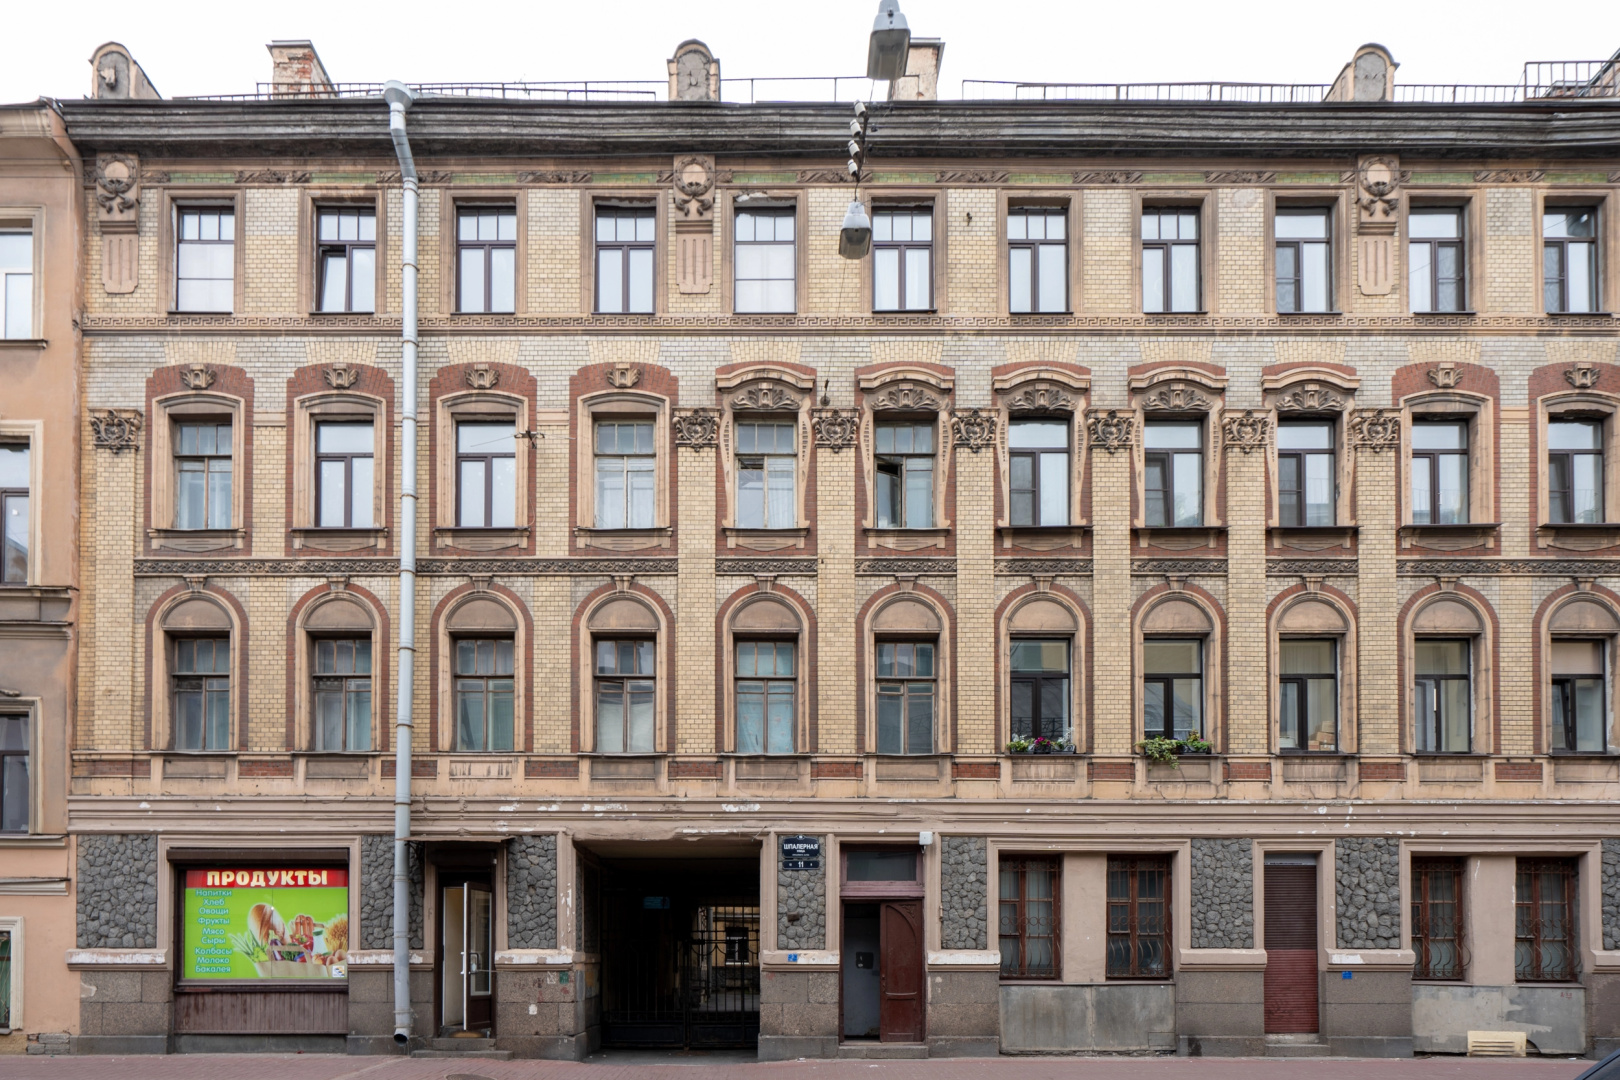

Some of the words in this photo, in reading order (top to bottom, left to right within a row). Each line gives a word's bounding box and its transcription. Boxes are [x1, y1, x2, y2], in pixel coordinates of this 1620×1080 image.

[207, 870, 328, 887] ПРОДУКТЫ
[195, 889, 232, 897] Напитки
[203, 898, 225, 906] Хлеб
[199, 907, 229, 915] Овощи
[197, 917, 230, 925] Фрукты
[201, 936, 226, 945] Сыры
[195, 947, 232, 955] Колбасы
[195, 965, 231, 973] Бакалея
